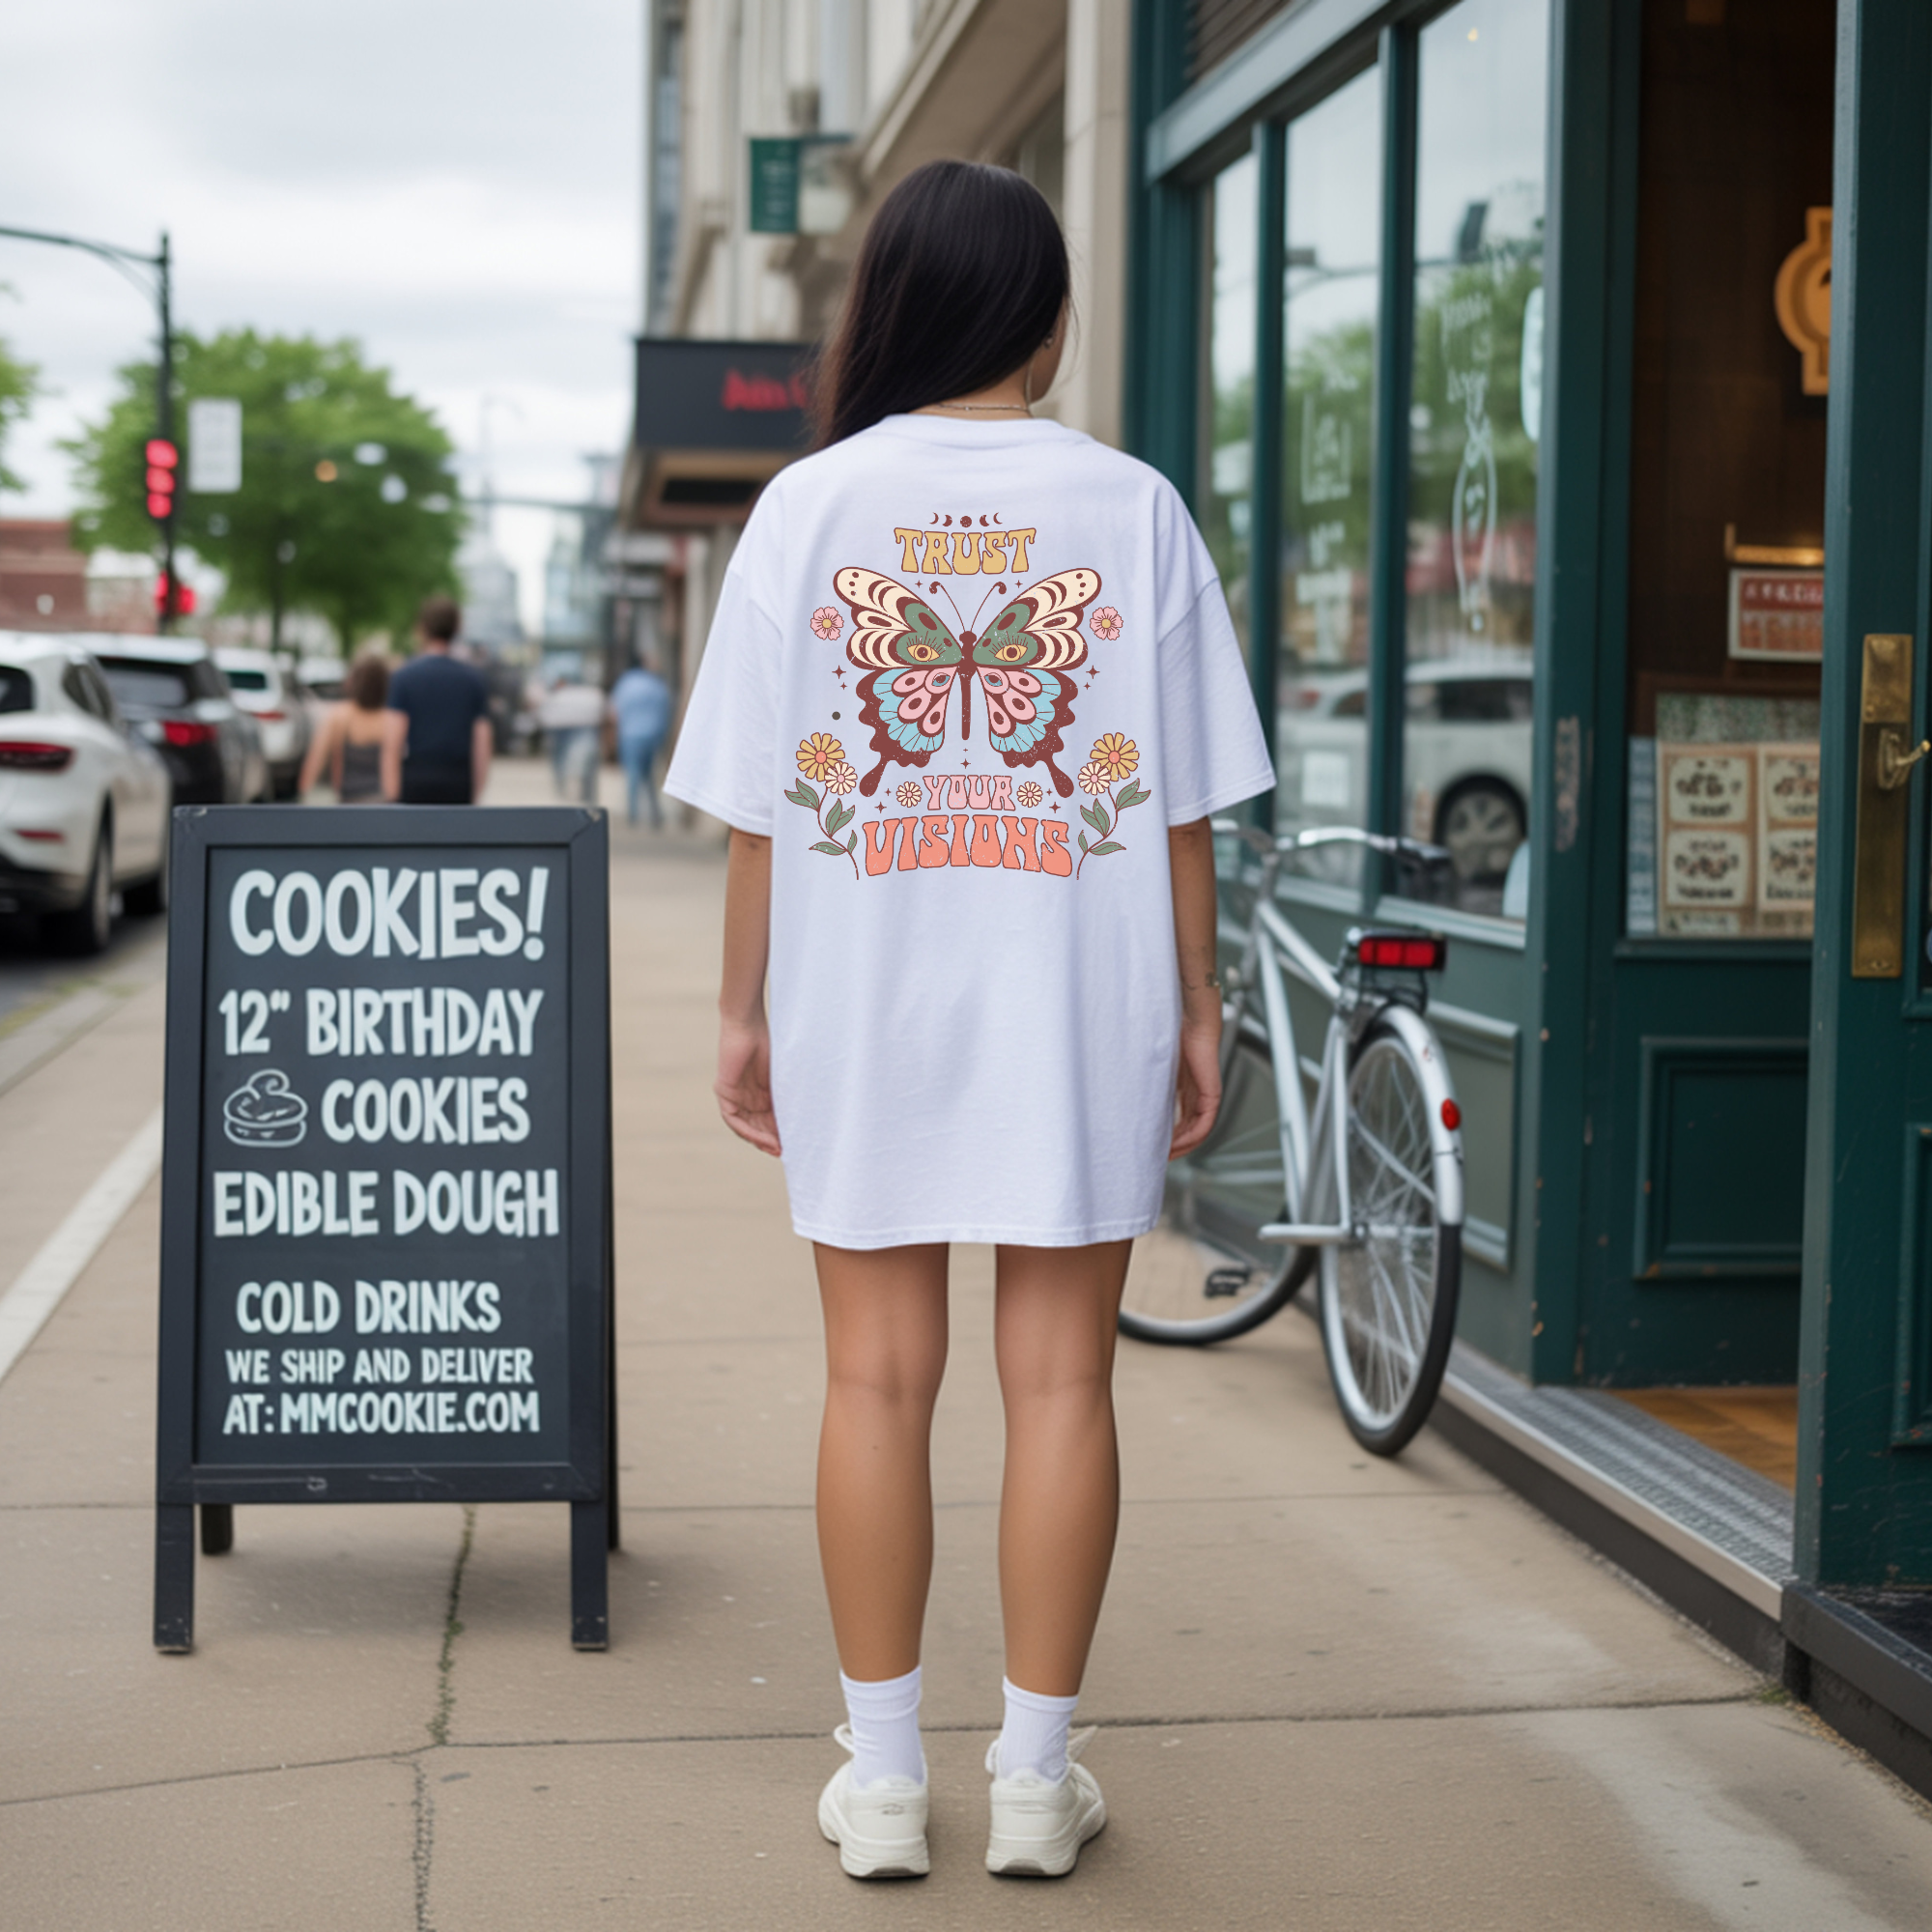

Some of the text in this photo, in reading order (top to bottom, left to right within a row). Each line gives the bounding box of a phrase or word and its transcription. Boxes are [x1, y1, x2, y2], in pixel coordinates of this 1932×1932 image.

[894, 527, 1037, 575] TRUST
[923, 775, 1016, 810] YOUR
[862, 814, 1072, 877] VISIONS
[230, 867, 549, 960] COOKIES!
[219, 987, 543, 1056] 12" BIRTHDAY
[322, 1077, 529, 1145] COOKIES
[214, 1169, 558, 1236] EDIBLE DOUGH
[238, 1281, 500, 1333] COLD DRINKS
[226, 1349, 533, 1383] WE SHIP AND DELIVER
[224, 1392, 539, 1434] AT: MMCOOKIE.COM
